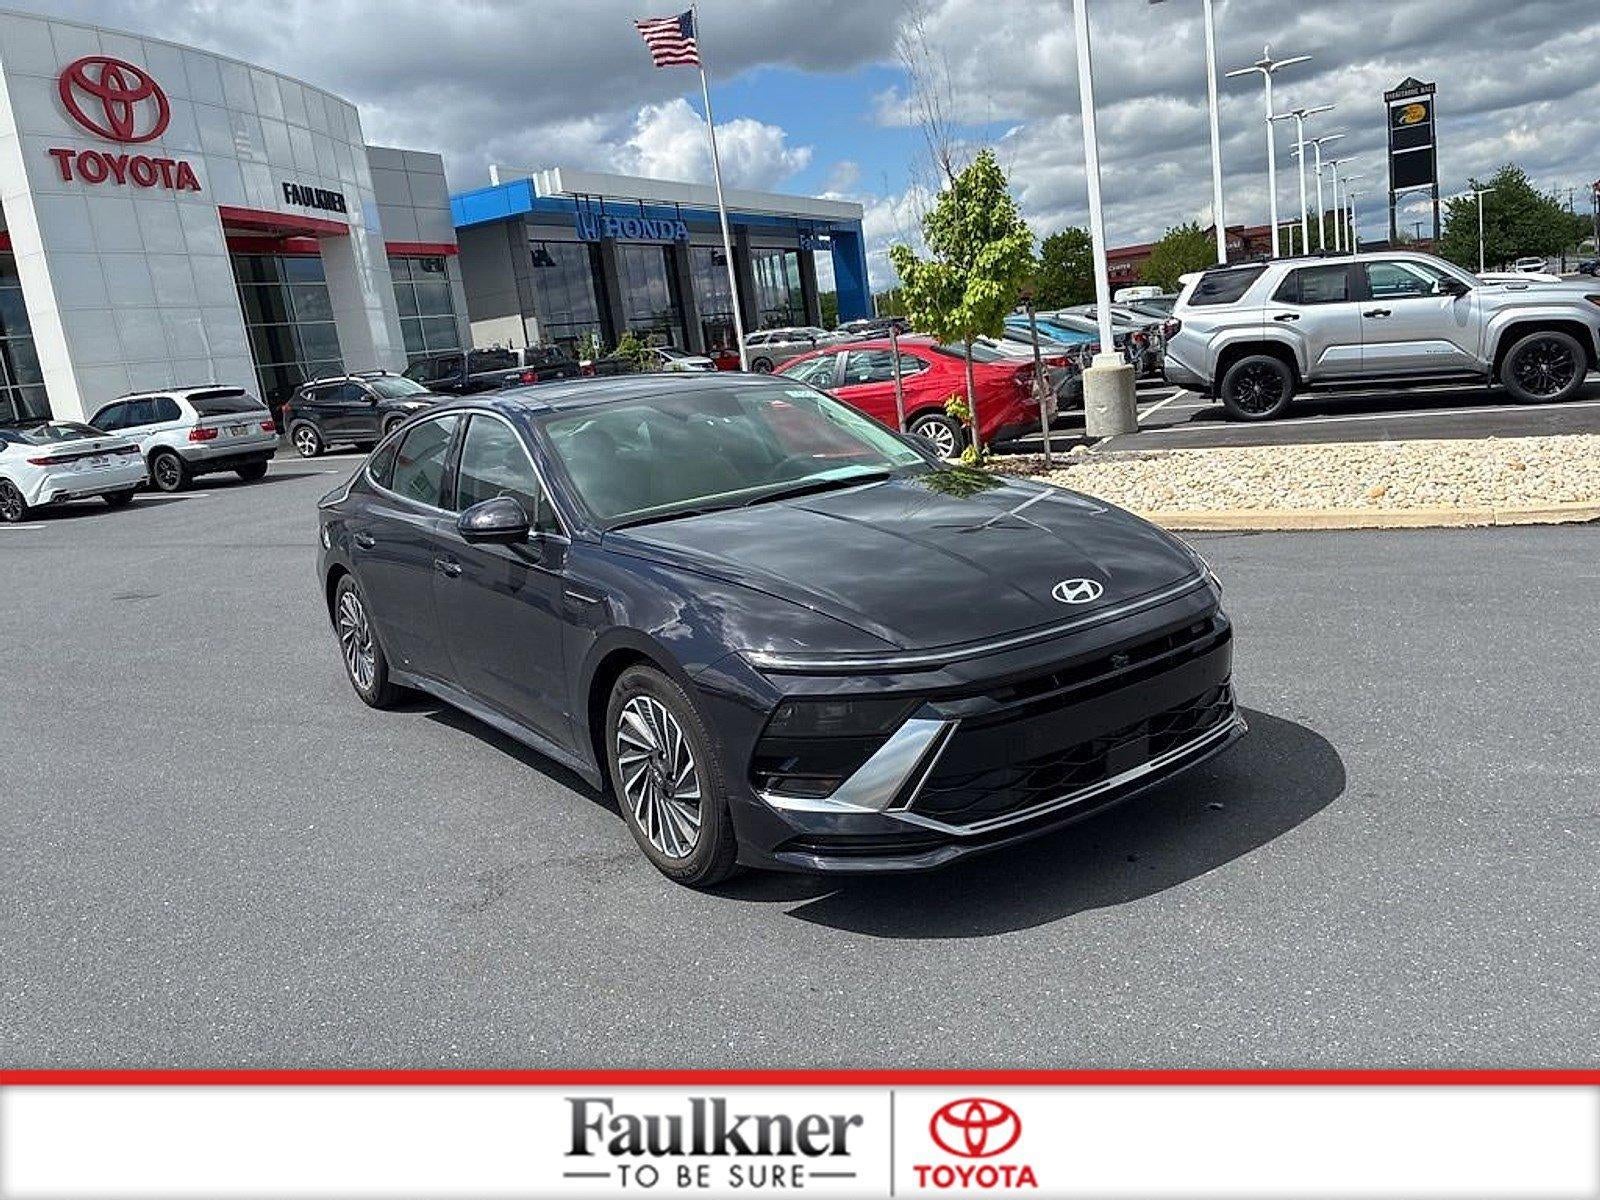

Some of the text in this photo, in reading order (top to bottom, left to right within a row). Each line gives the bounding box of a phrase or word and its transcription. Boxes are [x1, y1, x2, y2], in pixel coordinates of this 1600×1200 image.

[48, 148, 202, 192] TOYOTA
[281, 182, 347, 214] FAULKNER
[603, 216, 691, 241] HONDA
